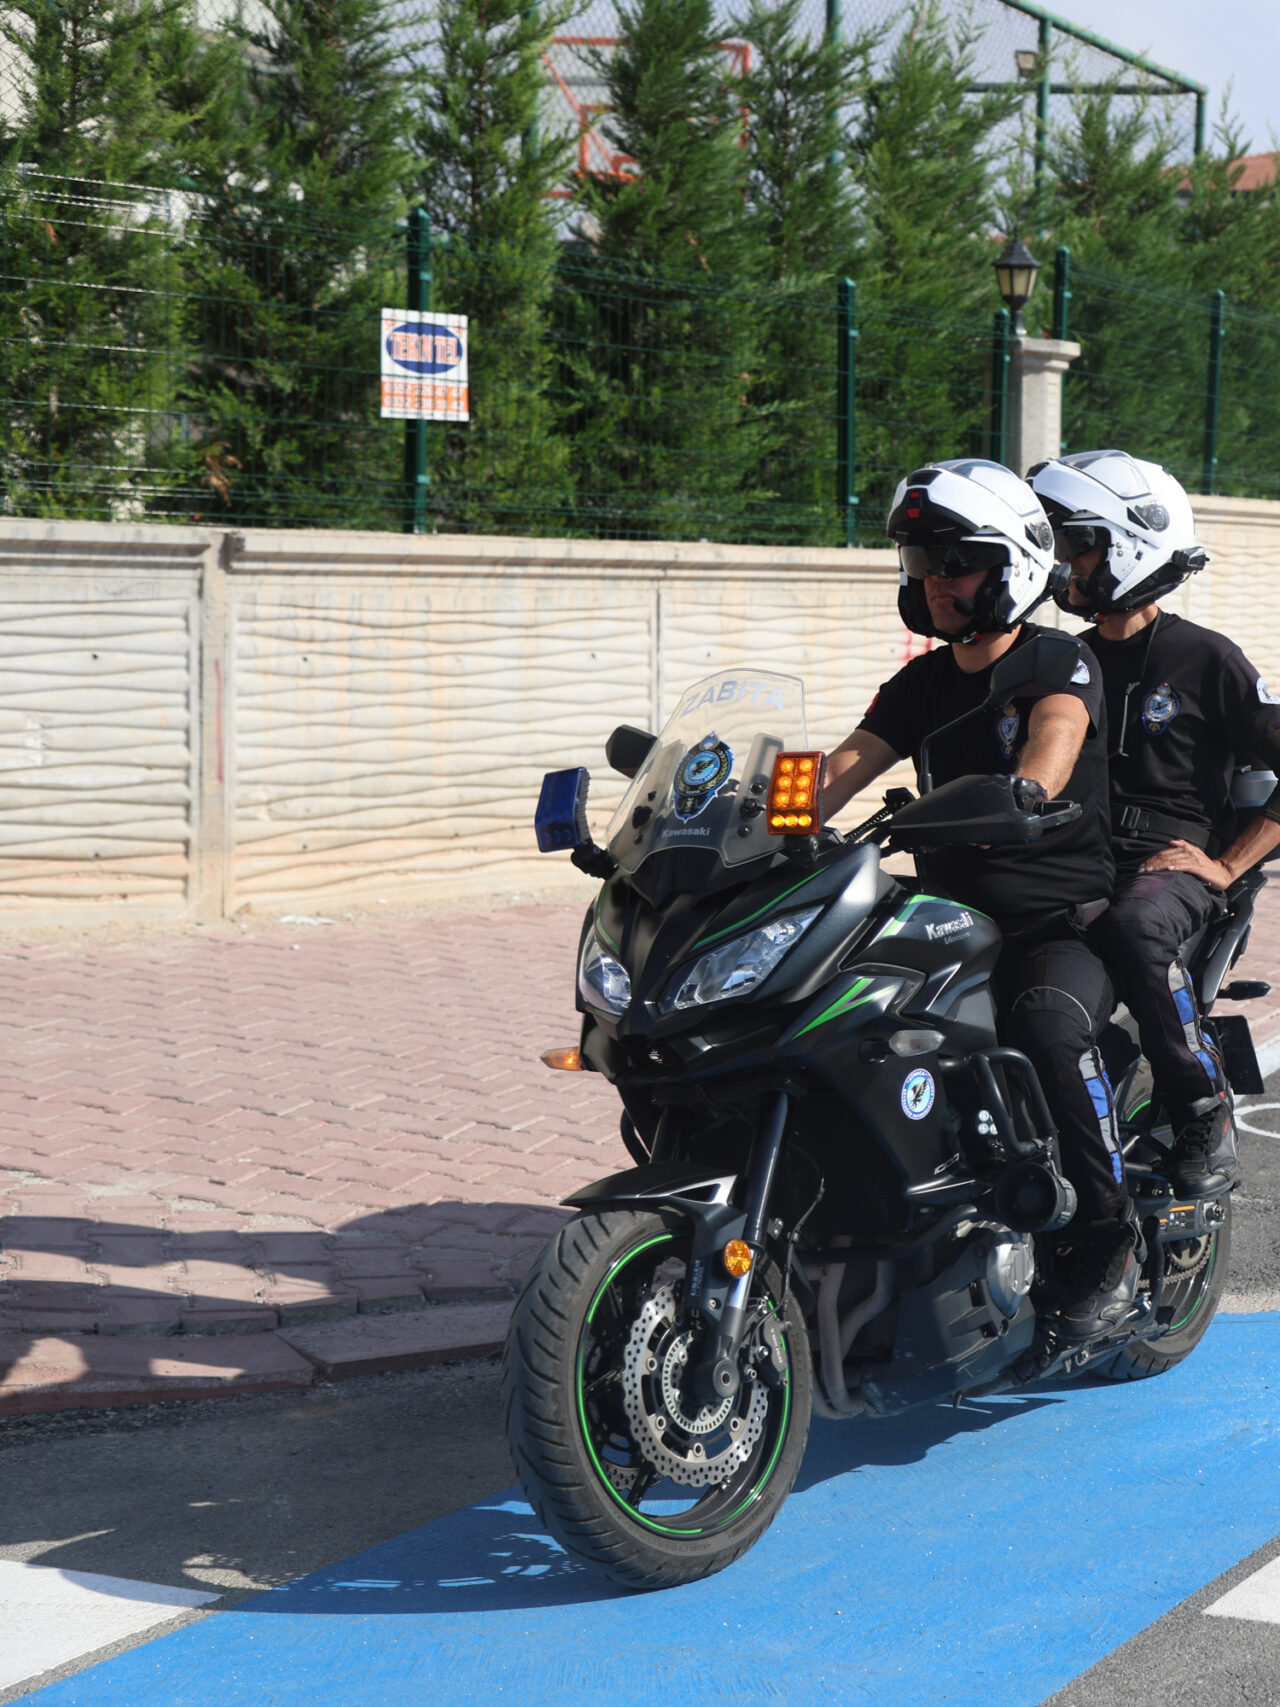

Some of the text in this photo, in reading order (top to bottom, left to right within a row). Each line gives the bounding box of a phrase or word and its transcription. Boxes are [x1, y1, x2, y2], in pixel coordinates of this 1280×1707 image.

[434, 335, 460, 365] TEL
[680, 680, 784, 718] ZABITA
[661, 826, 711, 839] Kawasaki
[925, 911, 974, 941] Kawasaki
[934, 1152, 960, 1175] 1000
